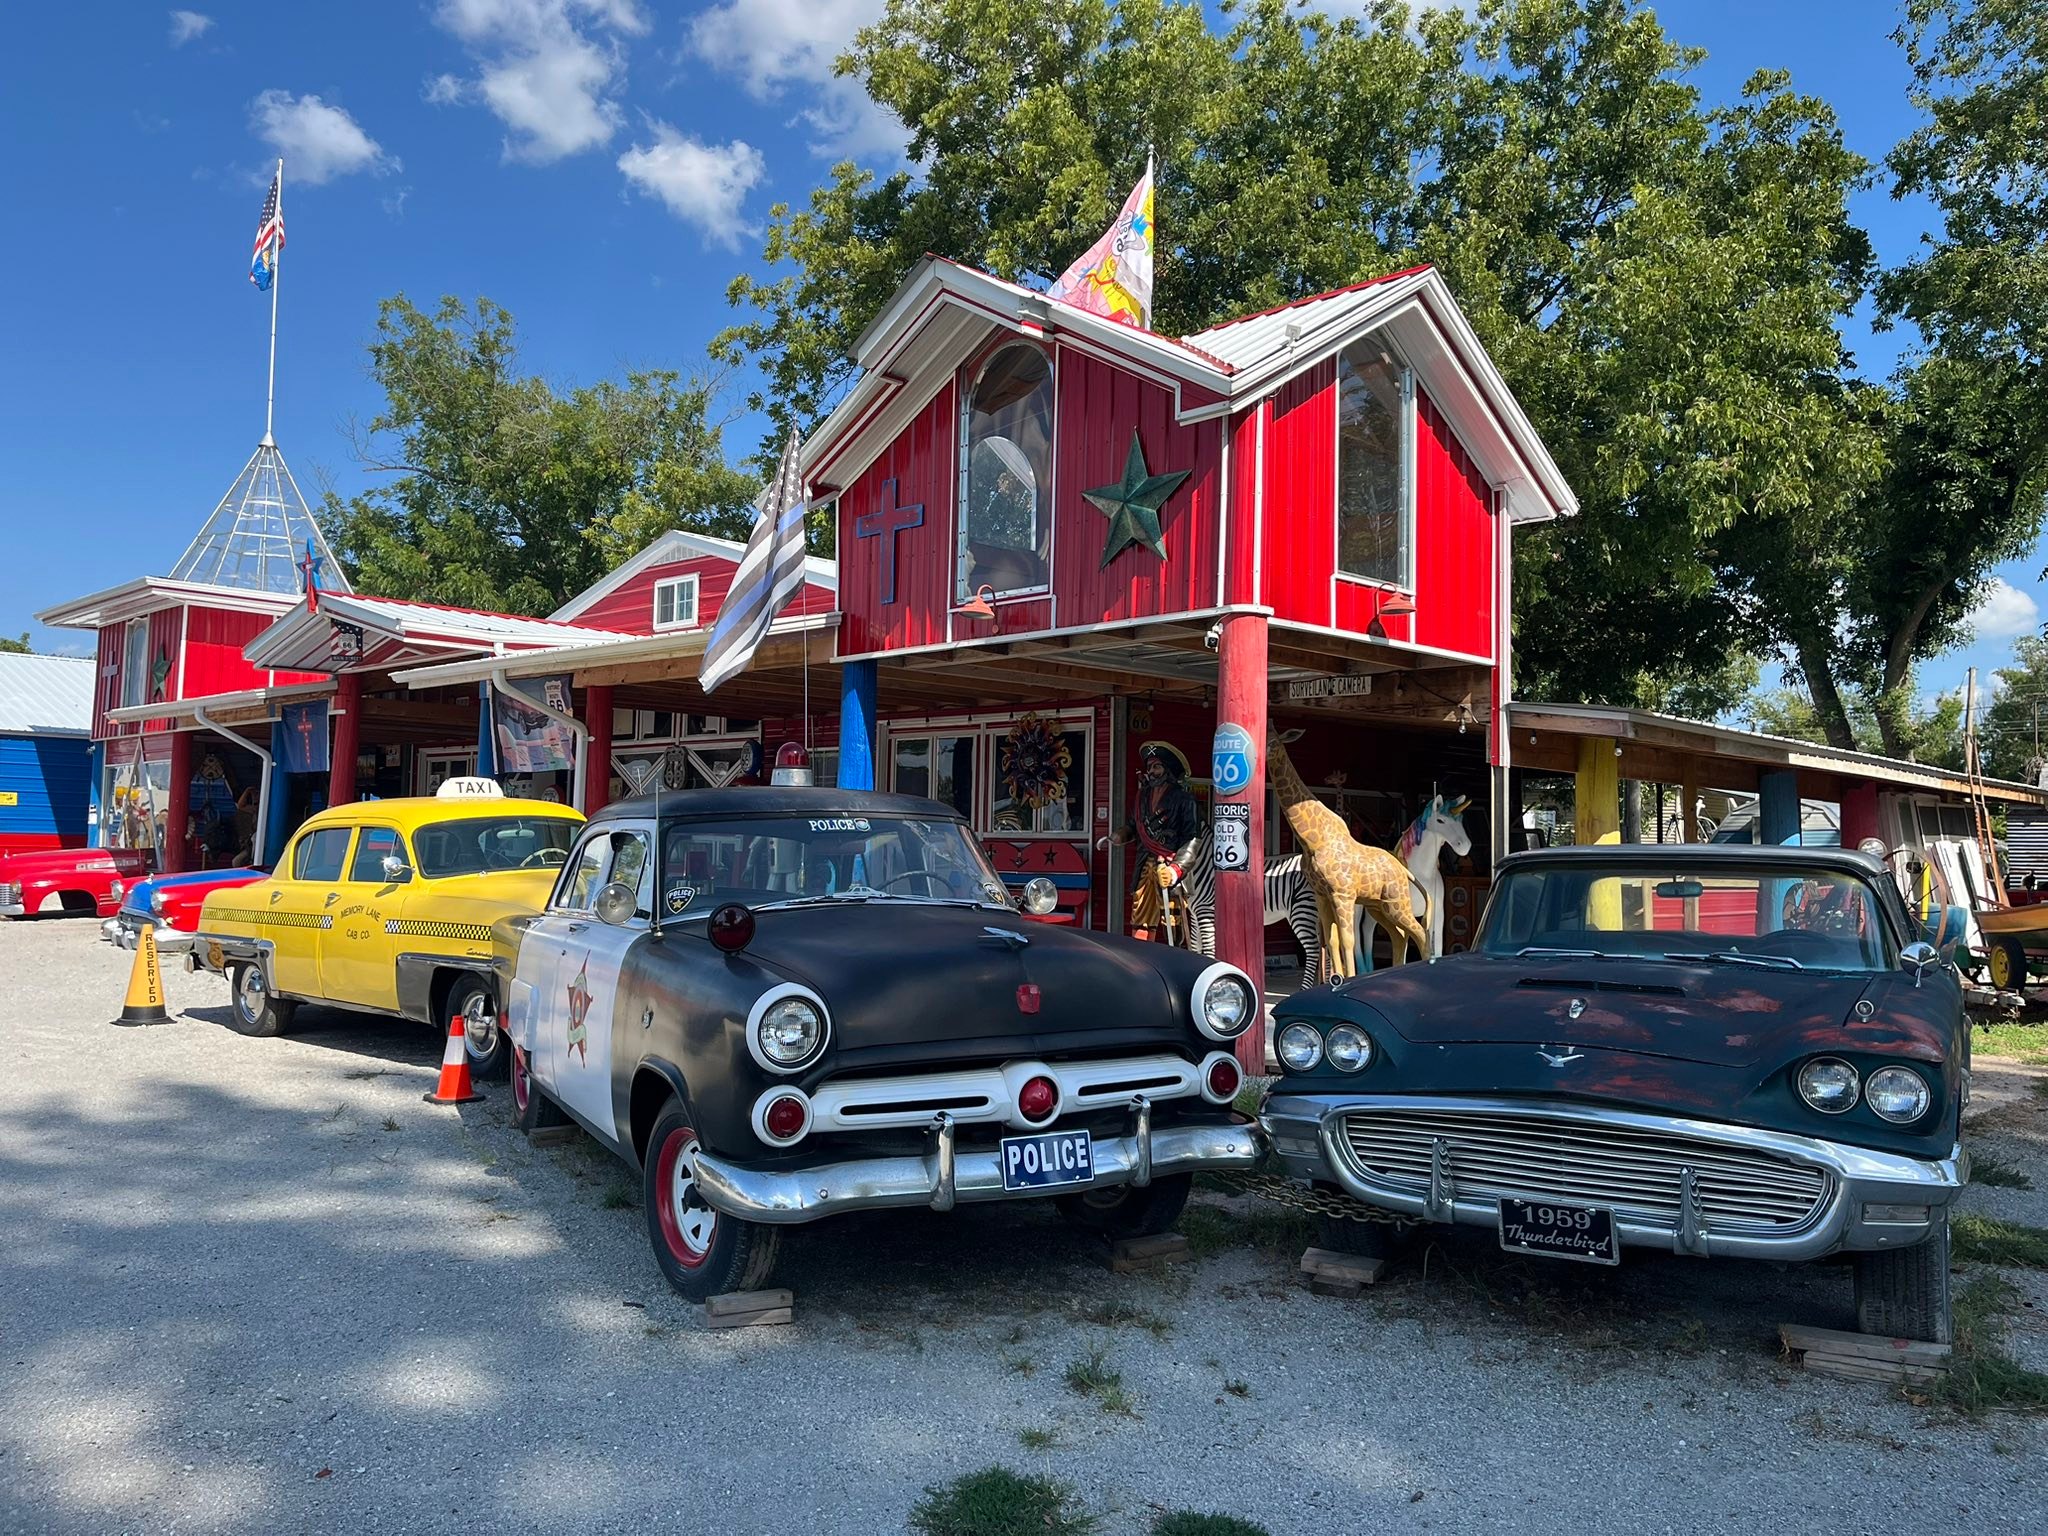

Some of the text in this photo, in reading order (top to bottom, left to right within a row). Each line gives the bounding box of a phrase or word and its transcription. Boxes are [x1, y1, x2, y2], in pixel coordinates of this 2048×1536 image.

[1291, 677, 1367, 697] SURVEILANE CAMERA
[1132, 714, 1149, 730] 66
[1213, 754, 1240, 783] 66
[455, 782, 492, 794] TAXI
[1215, 805, 1248, 816] STORIC
[808, 819, 855, 831] POLICE
[1216, 824, 1235, 834] OLD
[1215, 845, 1238, 863] 66
[668, 889, 693, 899] POLICE
[340, 904, 382, 922] MEMORY LANE
[346, 928, 358, 940] CAB
[145, 934, 156, 1003] RESERVED
[1008, 1138, 1089, 1176] POLICE
[1520, 1205, 1591, 1230] 1959
[1504, 1223, 1610, 1252] Thunderbird
